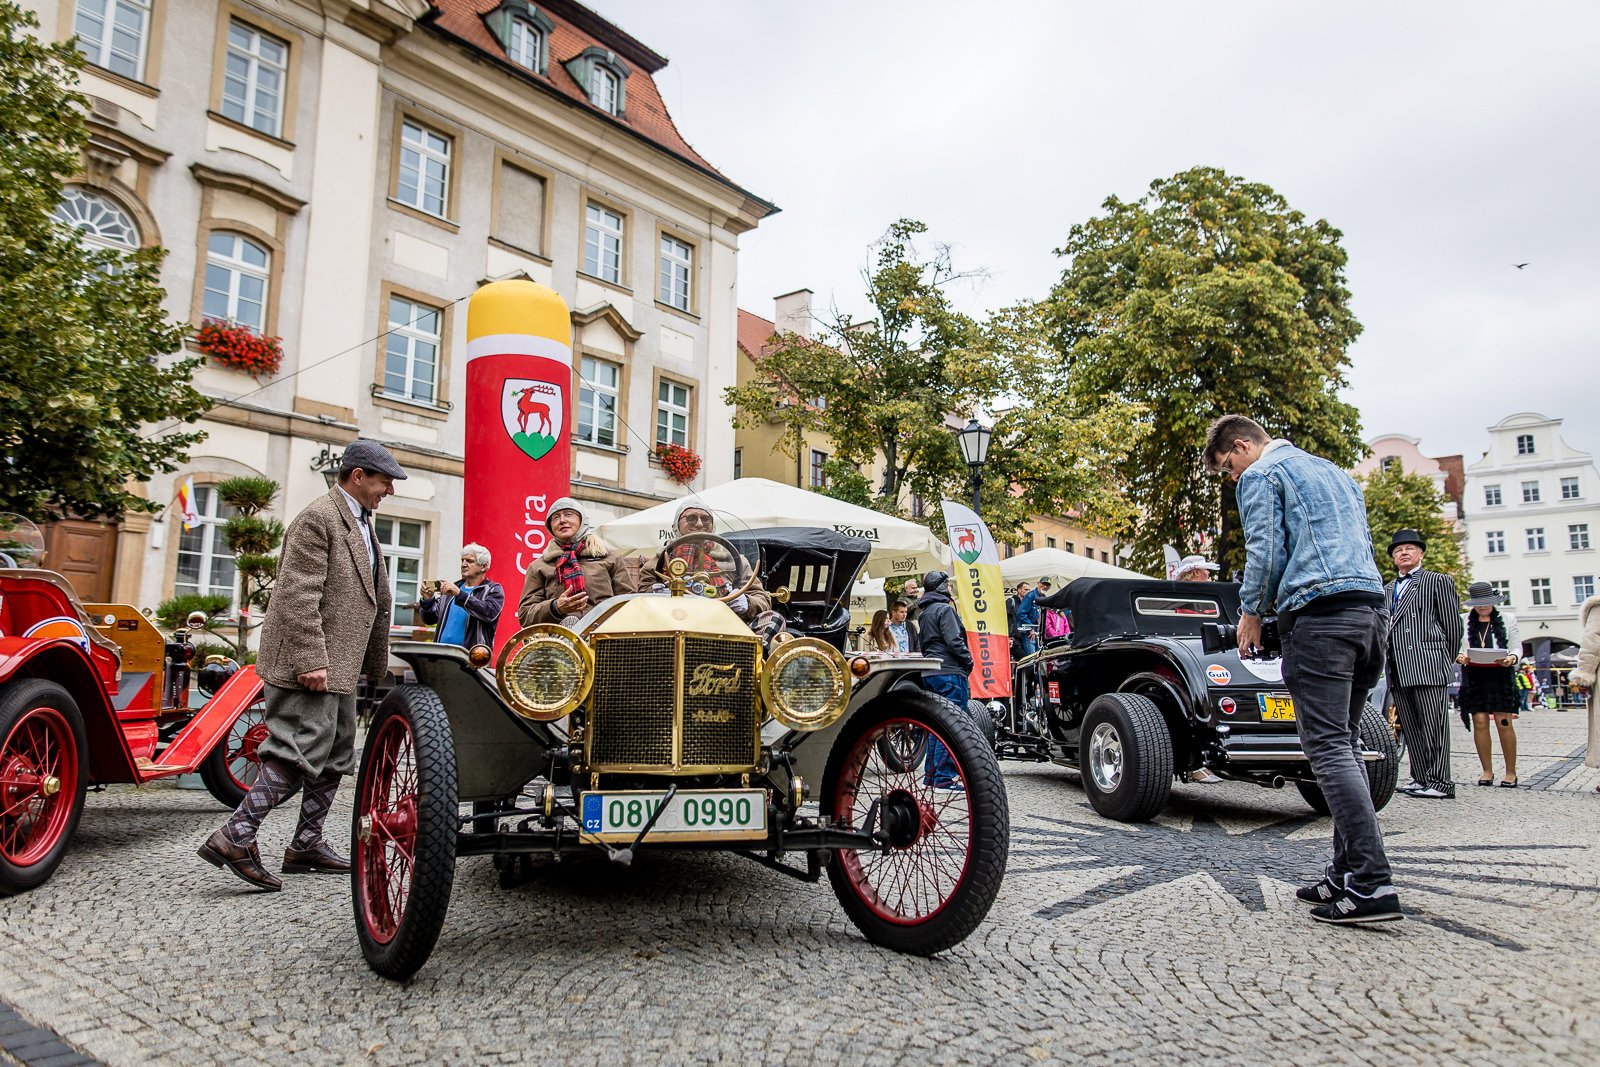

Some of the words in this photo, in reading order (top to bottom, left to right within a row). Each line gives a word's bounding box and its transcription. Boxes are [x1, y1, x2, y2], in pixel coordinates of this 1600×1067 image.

[833, 525, 880, 542] Kozel
[689, 663, 741, 695] Ford
[586, 819, 600, 829] CZ
[609, 799, 661, 828] 08V
[683, 797, 751, 826] 0990
